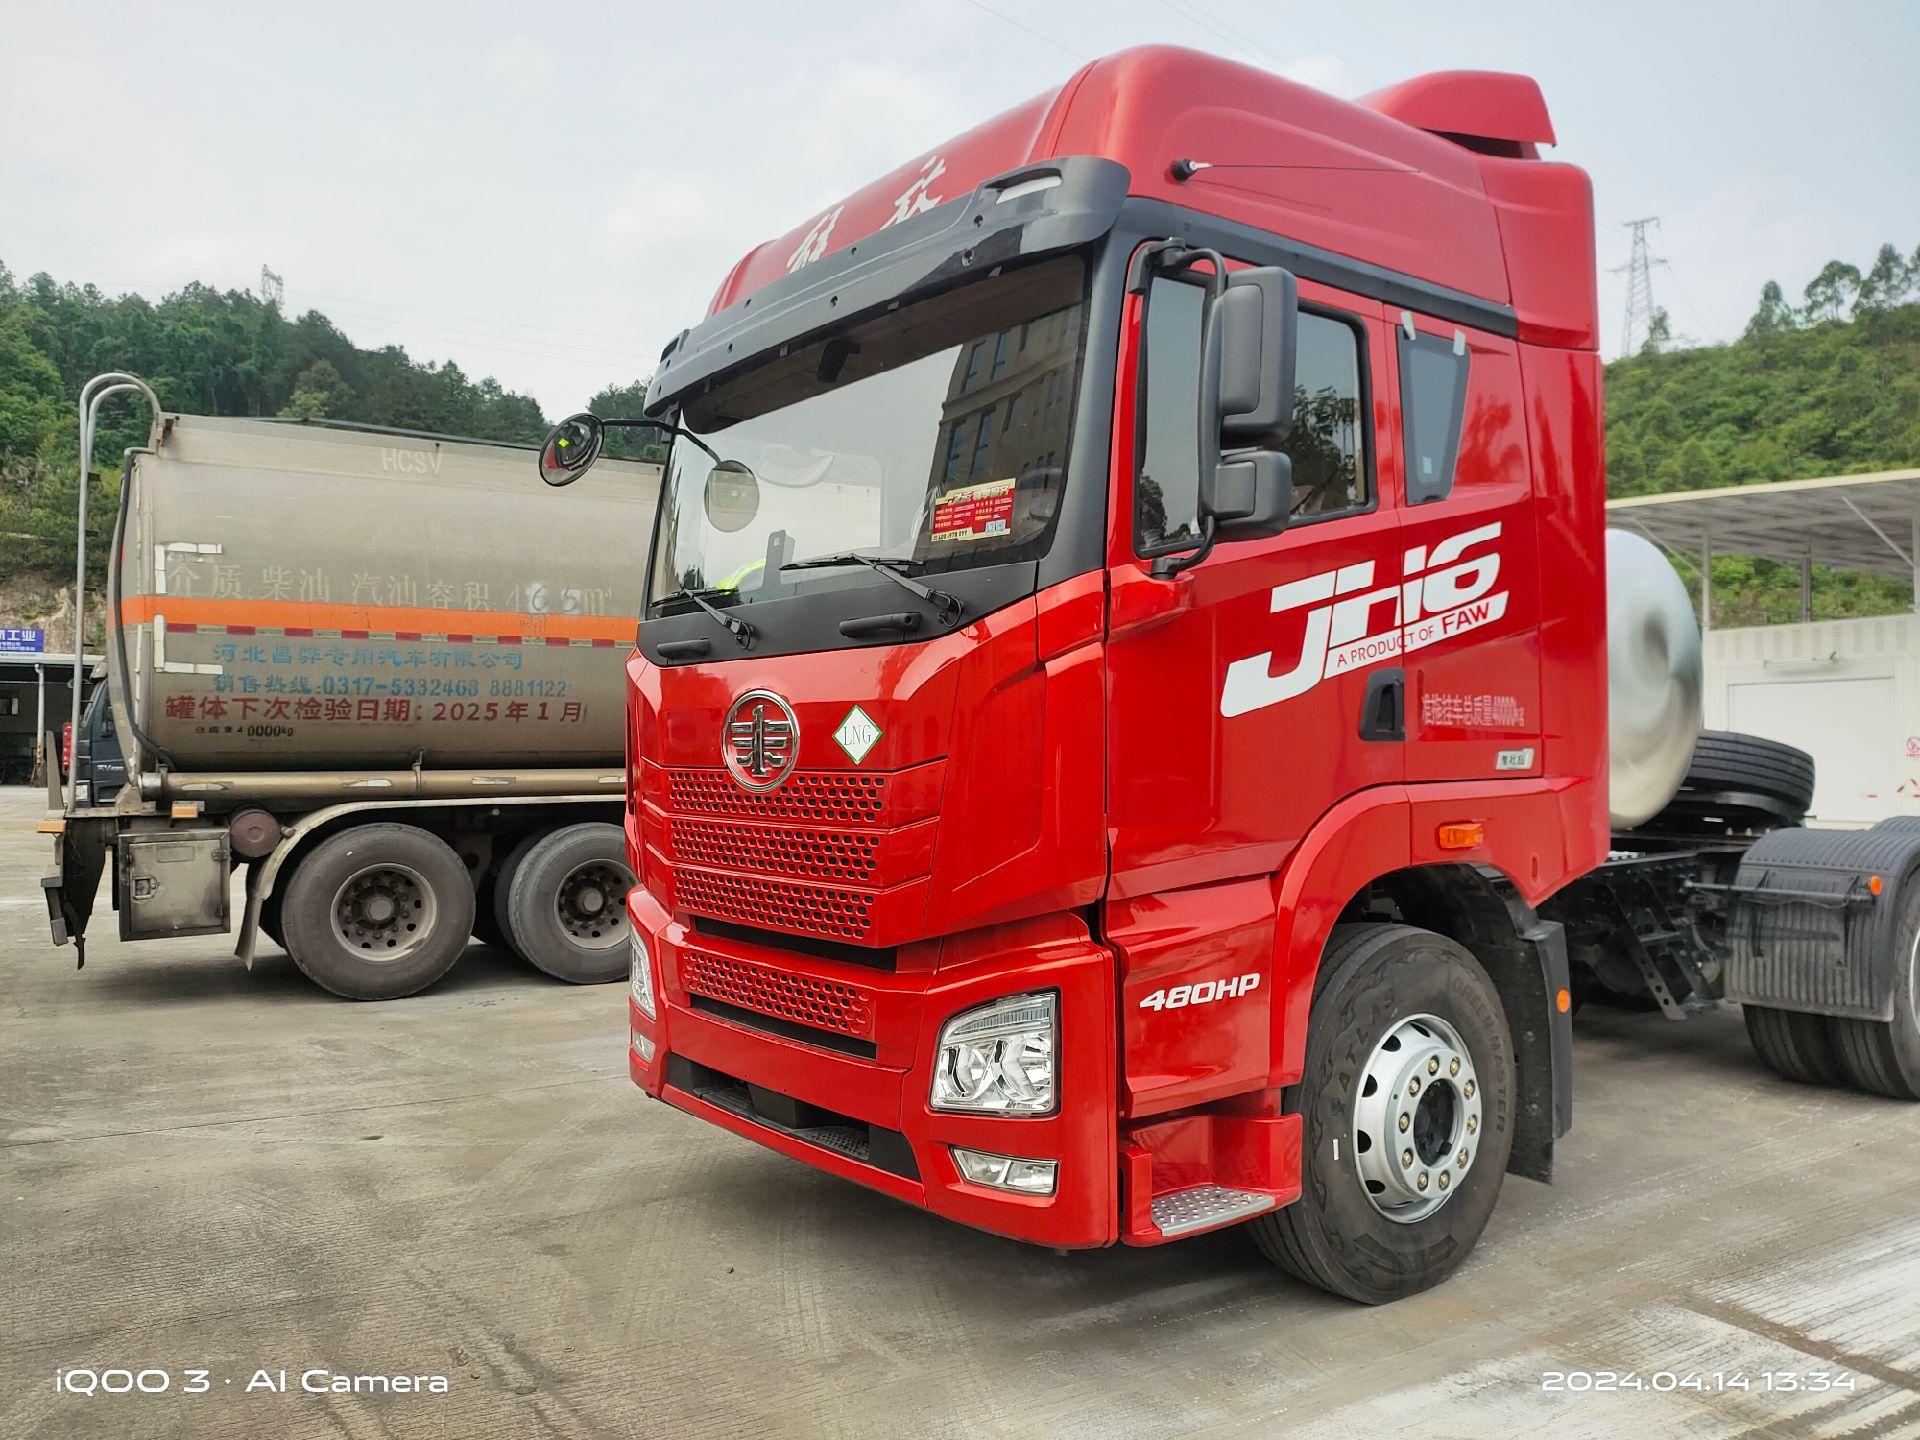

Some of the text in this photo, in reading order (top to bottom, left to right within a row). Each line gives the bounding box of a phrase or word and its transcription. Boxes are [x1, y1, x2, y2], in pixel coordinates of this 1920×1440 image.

[382, 447, 442, 474] HCSV
[1220, 521, 1502, 718] JH6
[1337, 602, 1490, 668] A PRODUCT OF FAW
[843, 724, 871, 746] LNG
[1140, 972, 1260, 1012] 480HP
